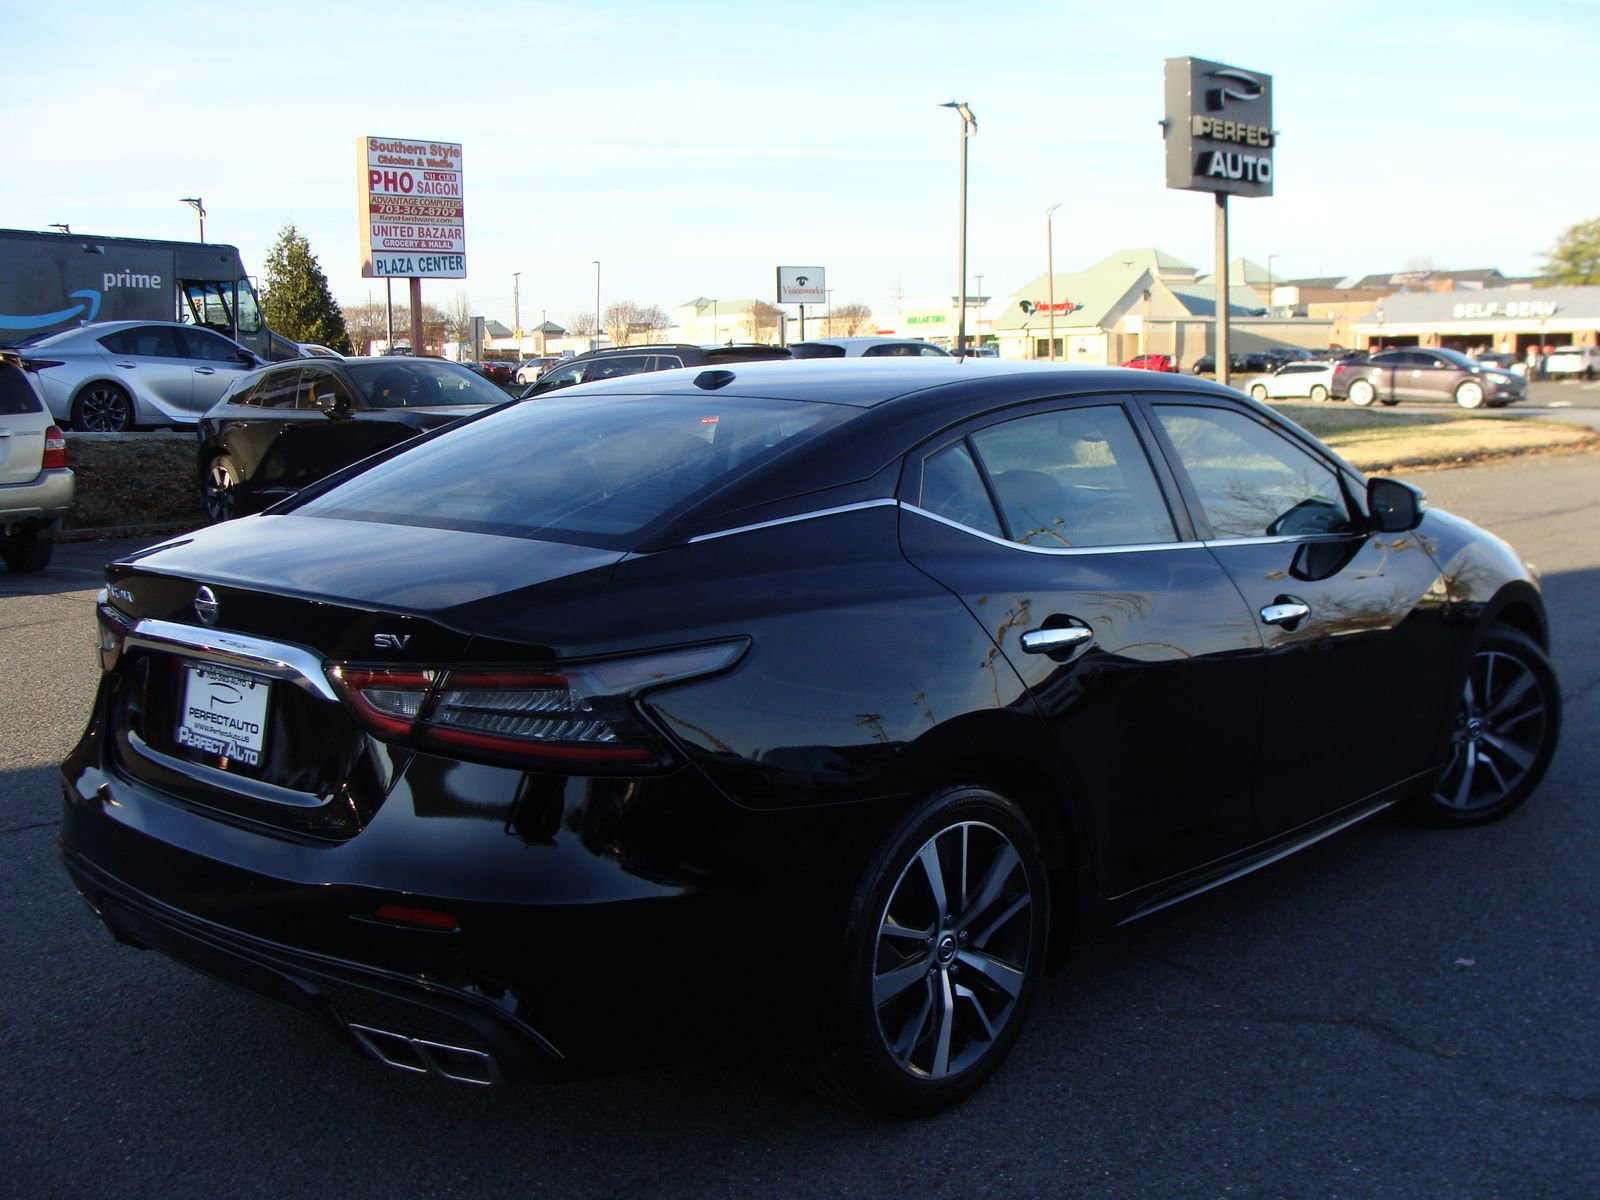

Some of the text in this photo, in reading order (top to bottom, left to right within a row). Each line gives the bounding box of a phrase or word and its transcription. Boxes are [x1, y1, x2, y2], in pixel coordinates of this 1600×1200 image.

[369, 139, 460, 159] Southern Style
[416, 158, 424, 167] &
[1207, 151, 1272, 182] AUTO
[368, 170, 459, 195] PHO SAIGON
[371, 196, 462, 208] ADVANTAGE COMPUTERS
[379, 204, 457, 216] 703-367-8709
[372, 225, 462, 240] UNITED BAZAAR
[384, 239, 418, 248] GROCERY
[428, 241, 452, 249] HALAL
[376, 255, 464, 275] PLAZA CENTER
[103, 269, 162, 292] prime
[374, 633, 411, 650] SV
